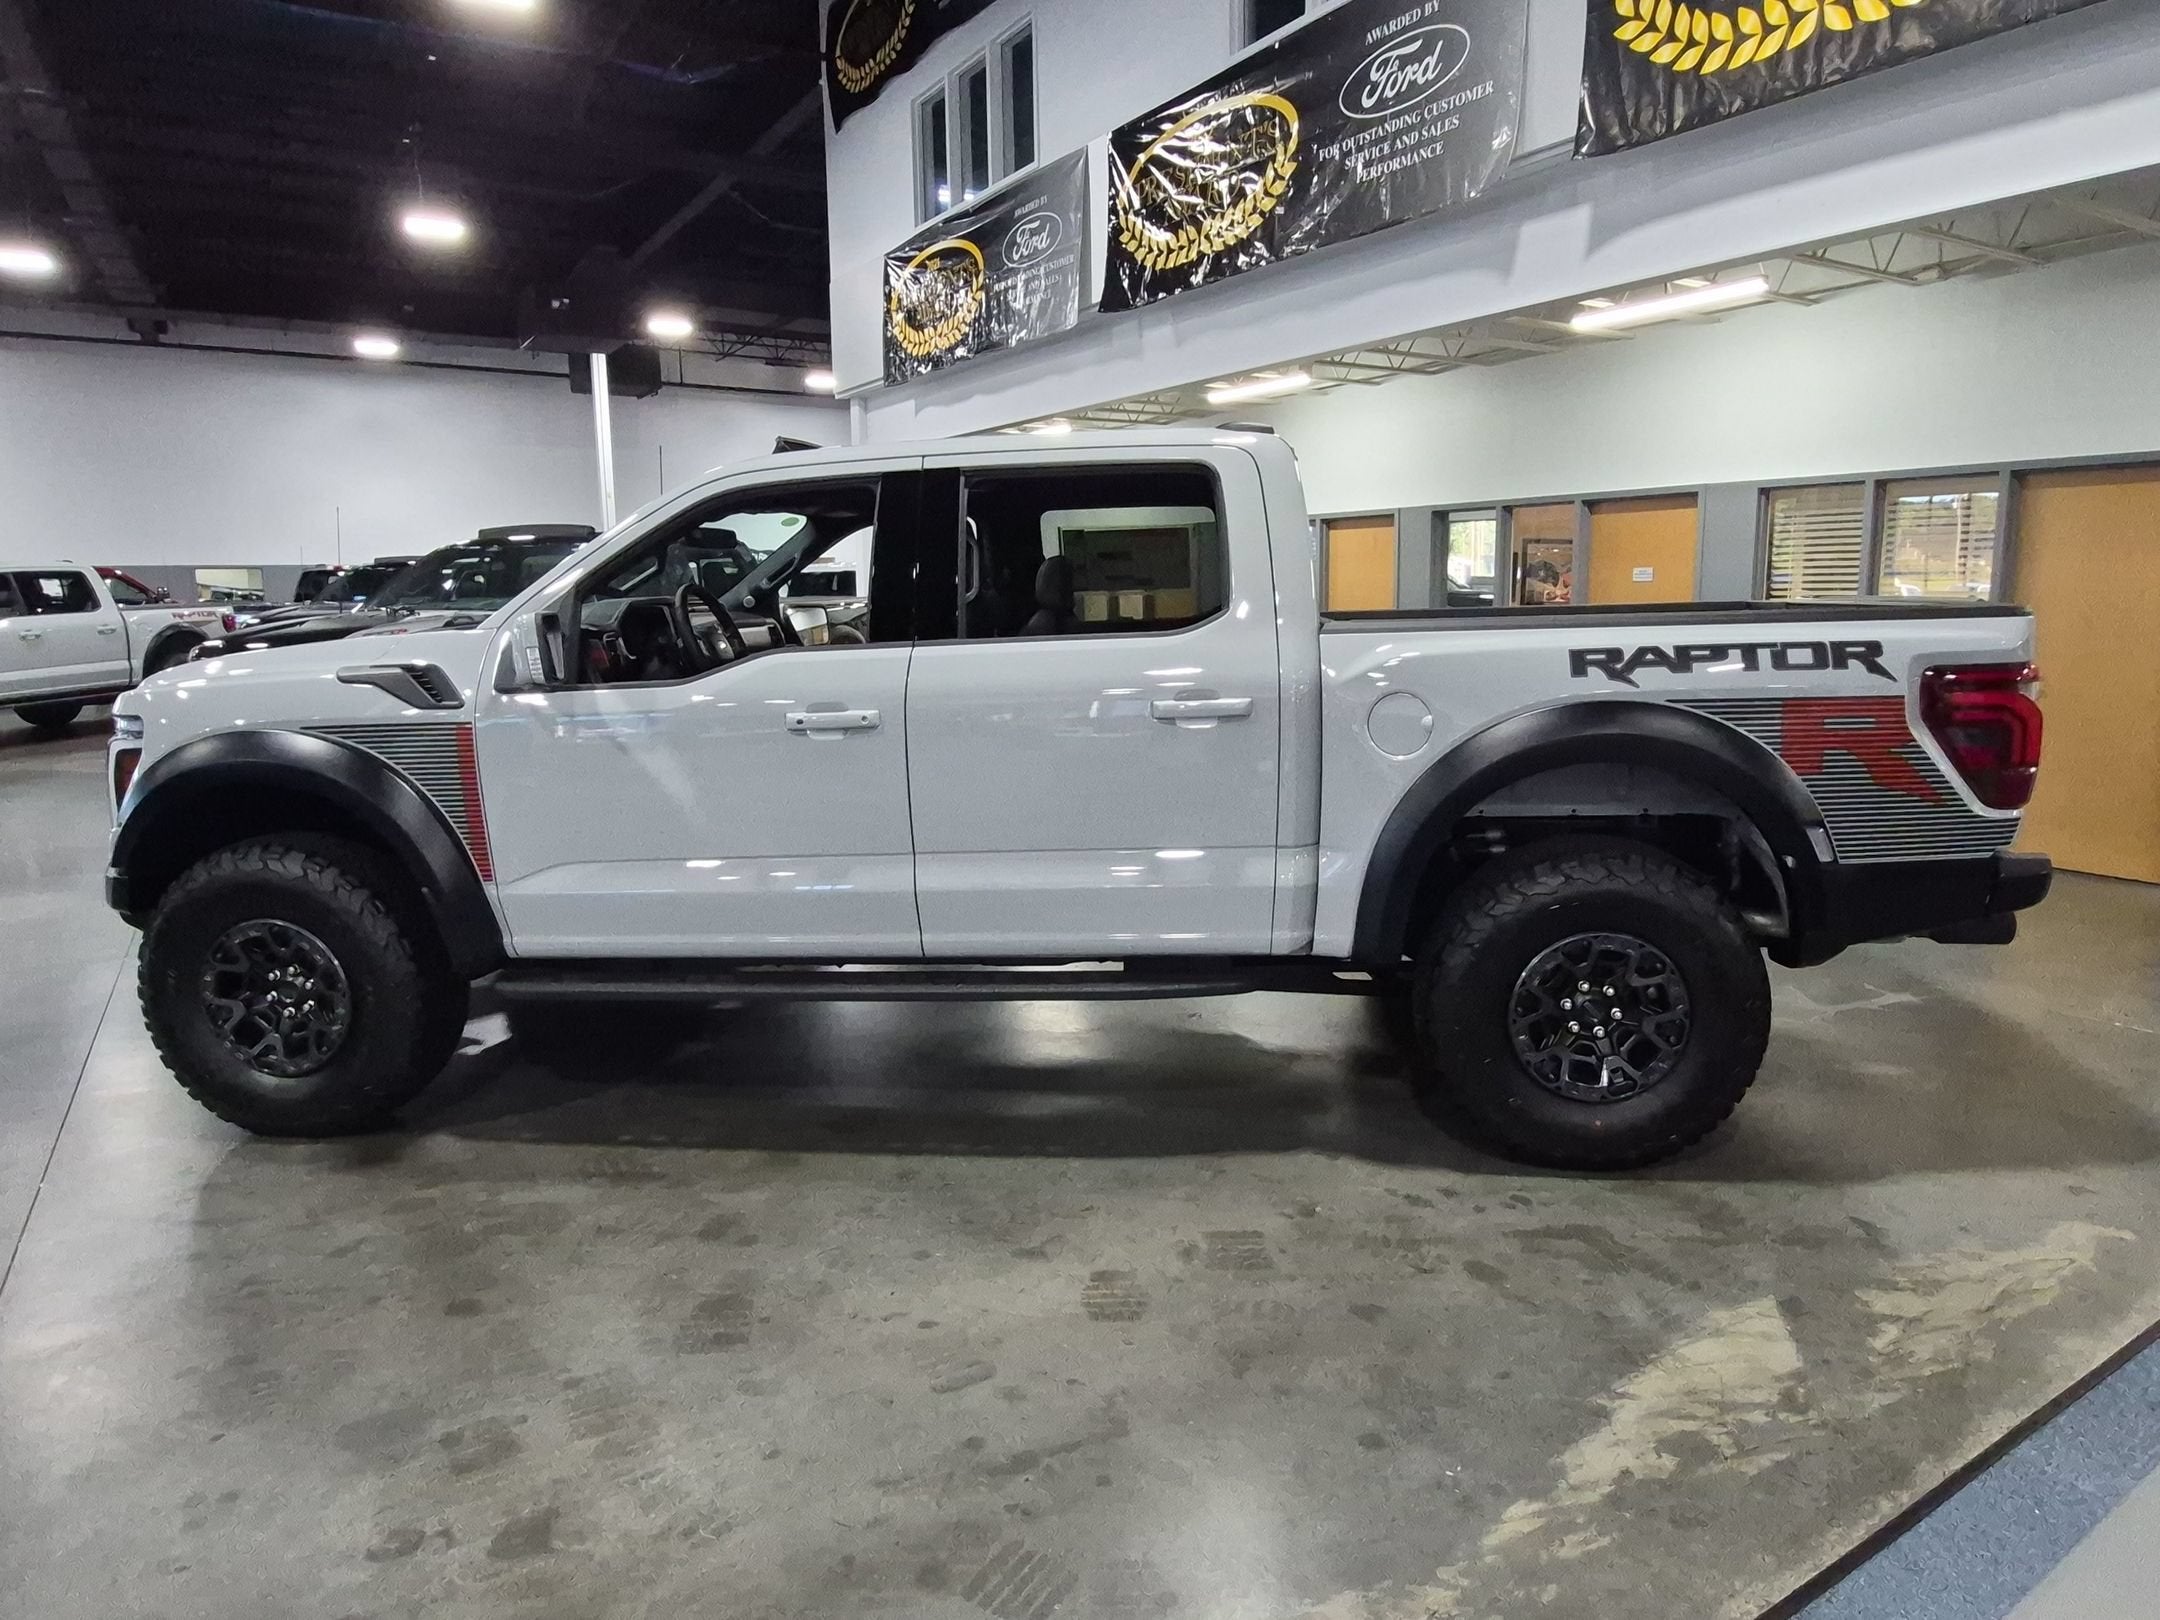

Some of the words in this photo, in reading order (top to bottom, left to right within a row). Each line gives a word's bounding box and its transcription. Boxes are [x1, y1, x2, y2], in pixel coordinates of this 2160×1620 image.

[1365, 8, 1421, 46] AWARDED
[1424, 0, 1440, 17] BY
[1361, 38, 1444, 109] Ford
[1318, 141, 1340, 162] FOR
[1342, 109, 1421, 153] OUTSTANDING
[1424, 80, 1494, 121] CUSTOMER
[1344, 140, 1391, 171] SERVICE
[1394, 131, 1419, 151] AND
[1421, 114, 1460, 142] SALES
[1356, 141, 1444, 184] PERFORMANCE
[1012, 219, 1051, 261] Ford
[1568, 640, 1898, 688] RAPTOR
